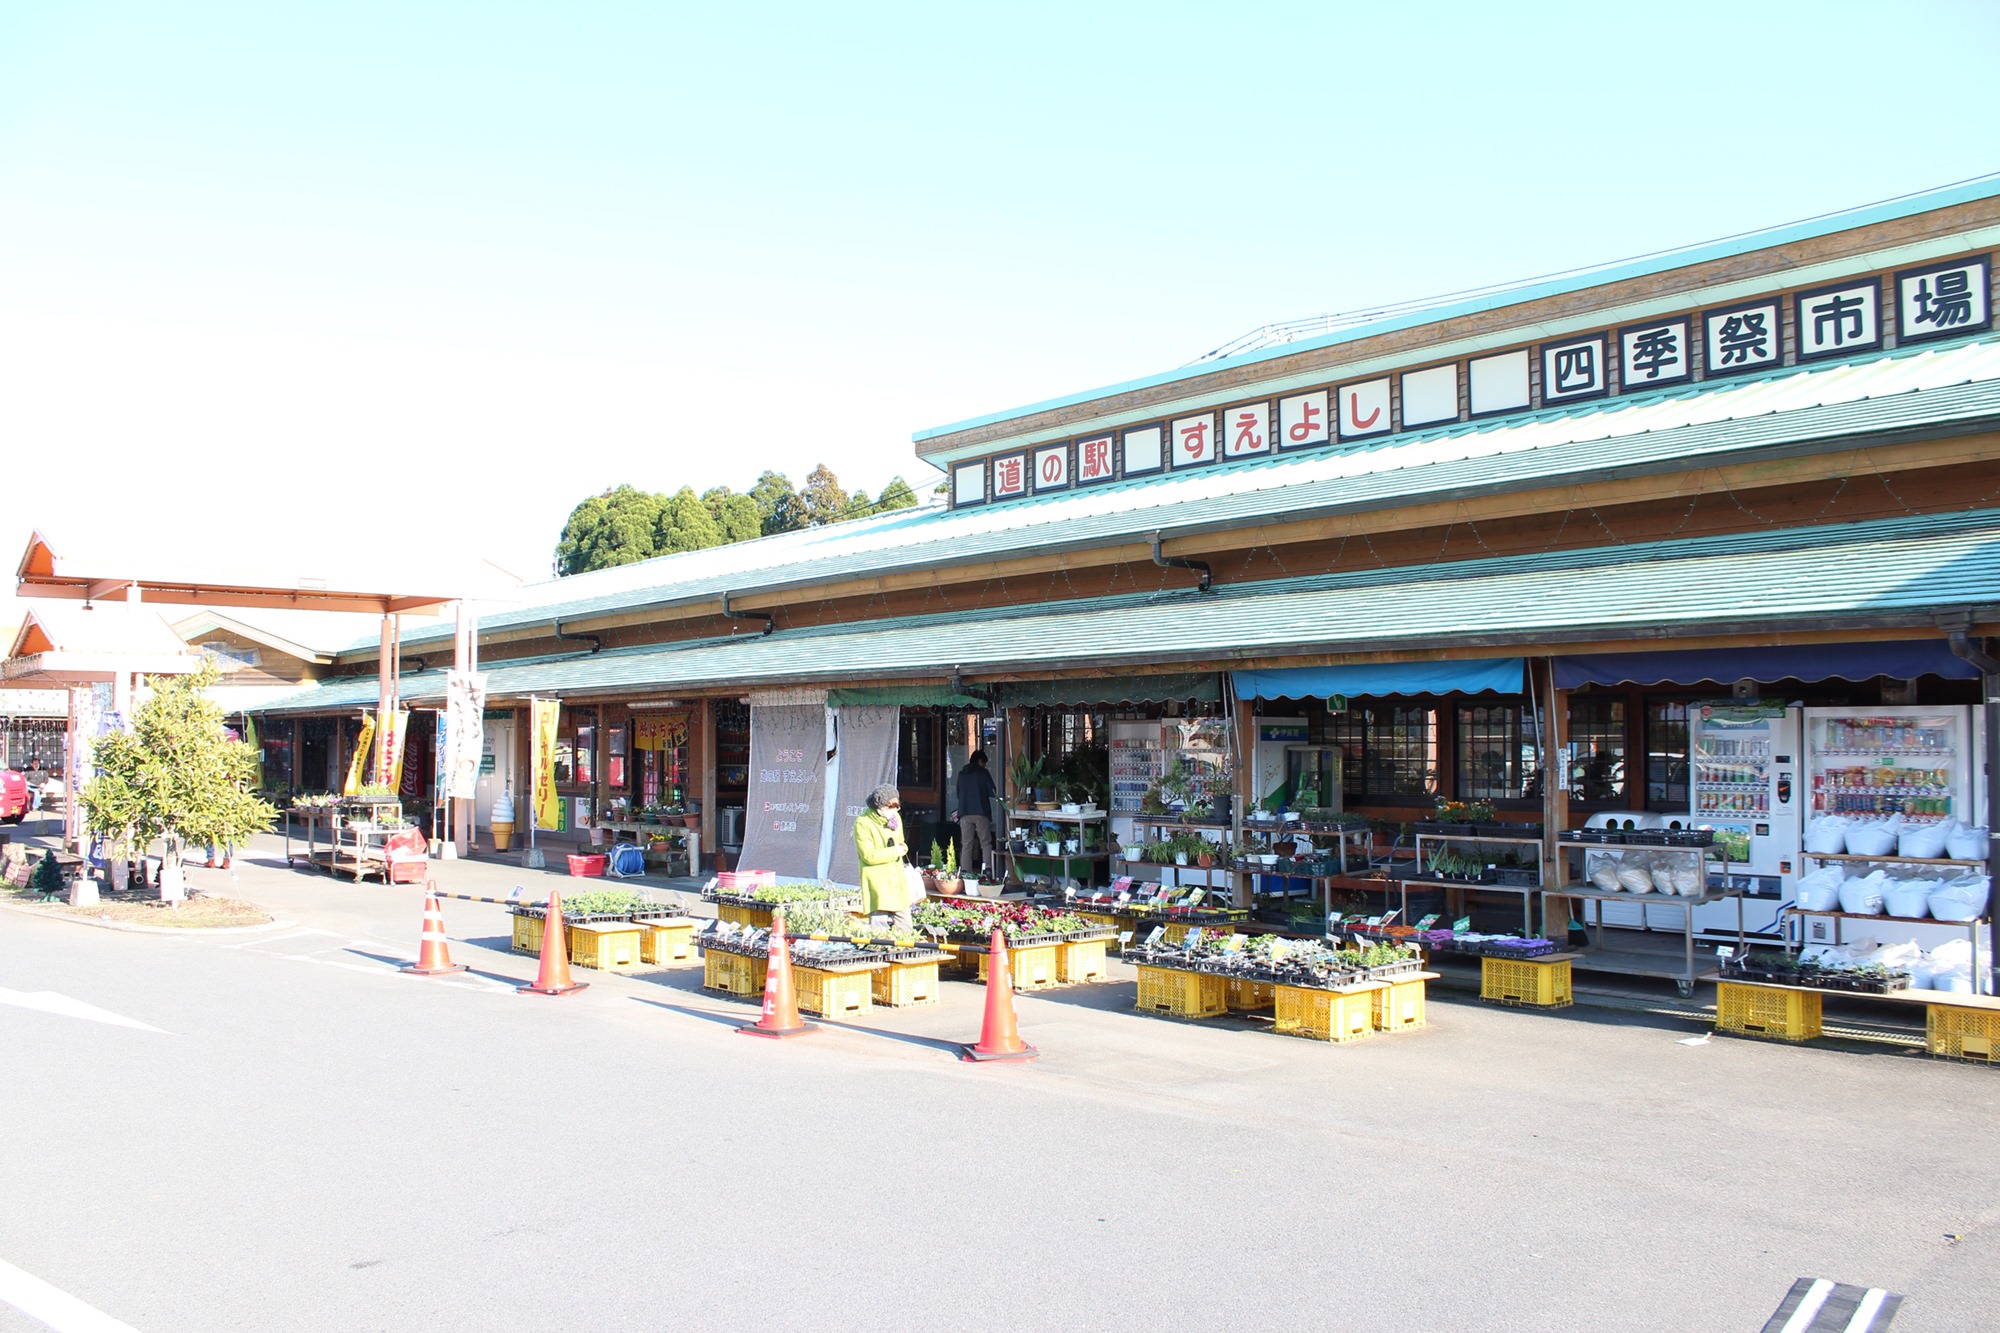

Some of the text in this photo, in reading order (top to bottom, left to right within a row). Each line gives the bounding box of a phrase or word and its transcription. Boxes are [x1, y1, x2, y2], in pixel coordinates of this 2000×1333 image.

[998, 270, 1973, 493] 道の駅 すえよし 四季祭市場
[776, 748, 804, 763] ようこそ
